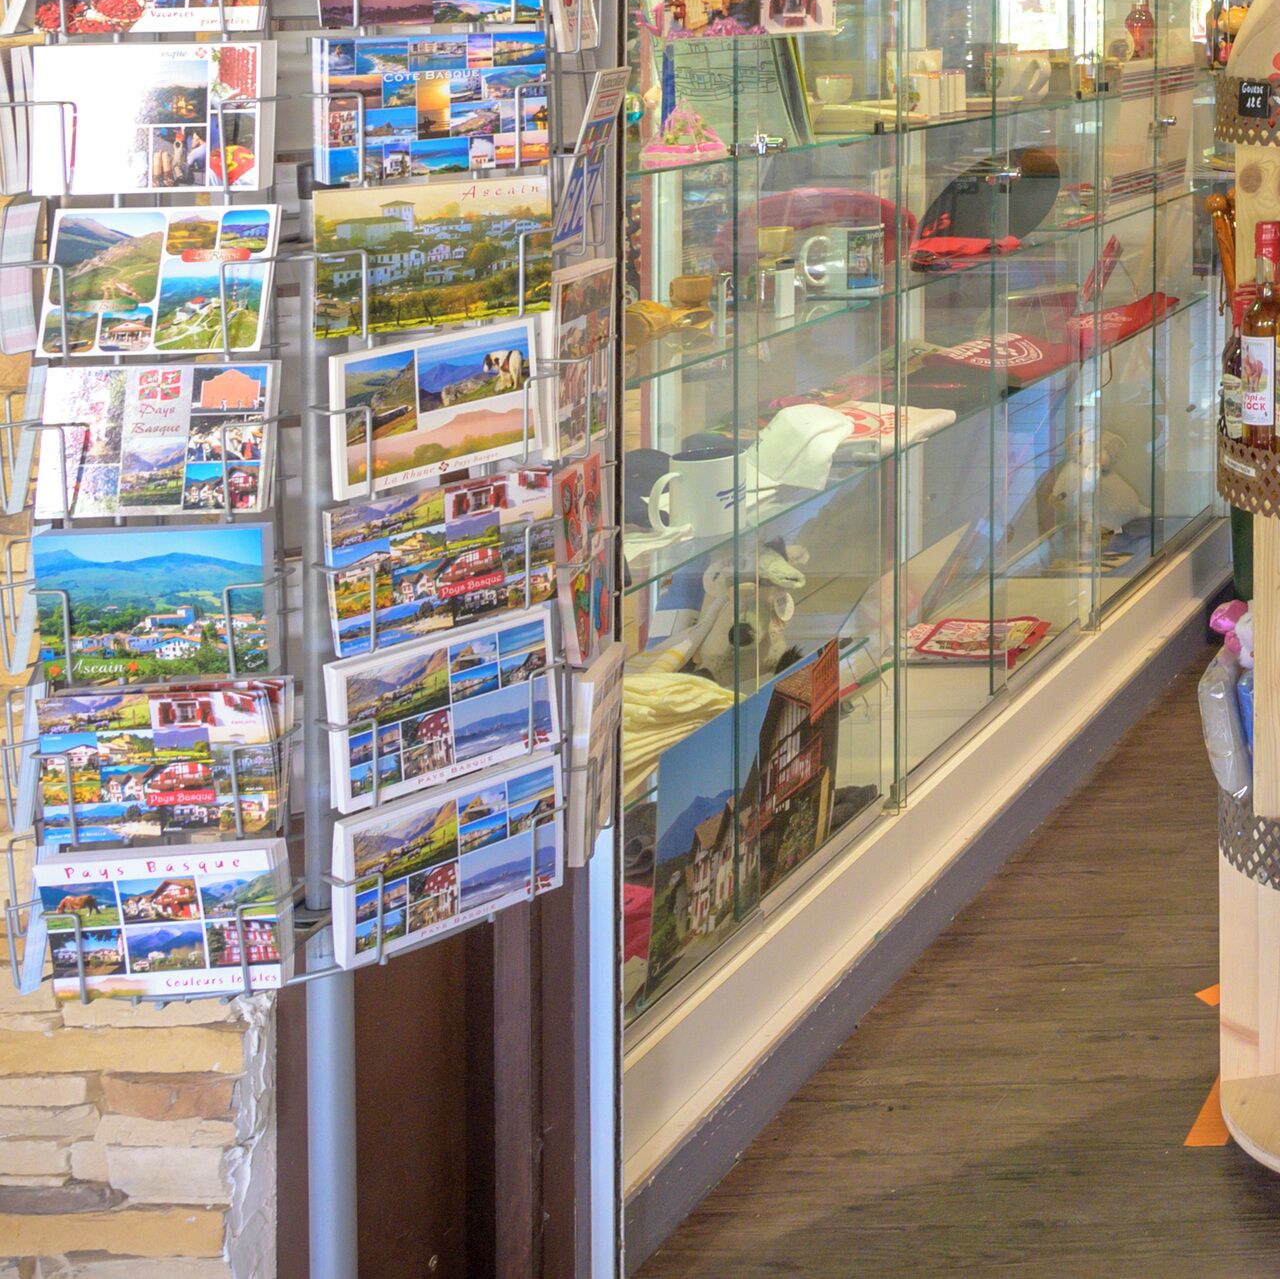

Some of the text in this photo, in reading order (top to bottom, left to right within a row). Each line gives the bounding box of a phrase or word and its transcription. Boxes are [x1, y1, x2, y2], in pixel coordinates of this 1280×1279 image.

[426, 69, 481, 81] BASQUE
[461, 183, 542, 201] Ascain
[64, 857, 241, 880] Pays Basque
[165, 973, 278, 988] Couleurs loales
